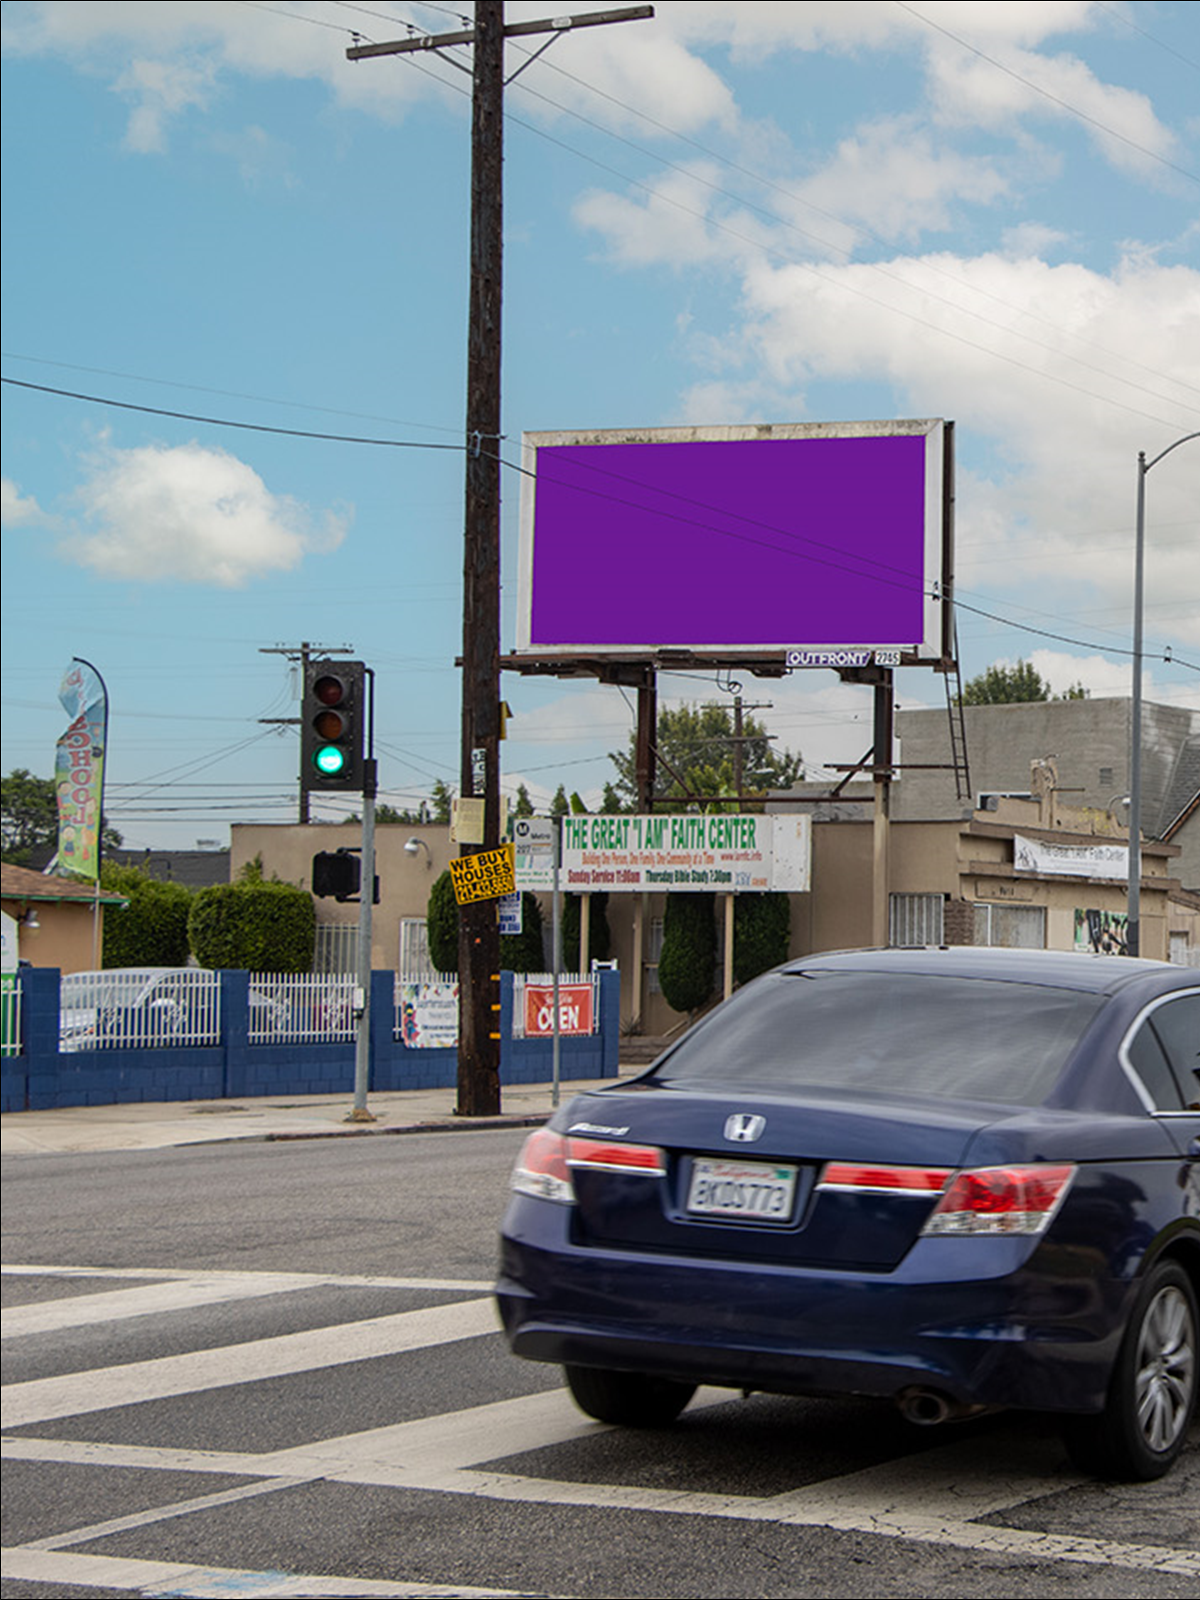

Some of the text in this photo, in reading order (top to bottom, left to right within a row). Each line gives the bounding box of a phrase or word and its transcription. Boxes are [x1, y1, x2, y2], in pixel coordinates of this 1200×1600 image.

[790, 652, 866, 665] OUTFRONT
[565, 818, 588, 849] THE
[590, 818, 630, 849] GREAT
[645, 818, 669, 849] AM"
[671, 818, 706, 849] FAITH
[708, 818, 757, 849] CENTER
[450, 850, 507, 872] WE BUY
[453, 862, 511, 885] HOUSES
[568, 869, 590, 884] Sunday
[592, 869, 615, 883] Service
[645, 869, 673, 884] Thursday
[674, 869, 690, 883] Bible
[691, 869, 708, 884] Study
